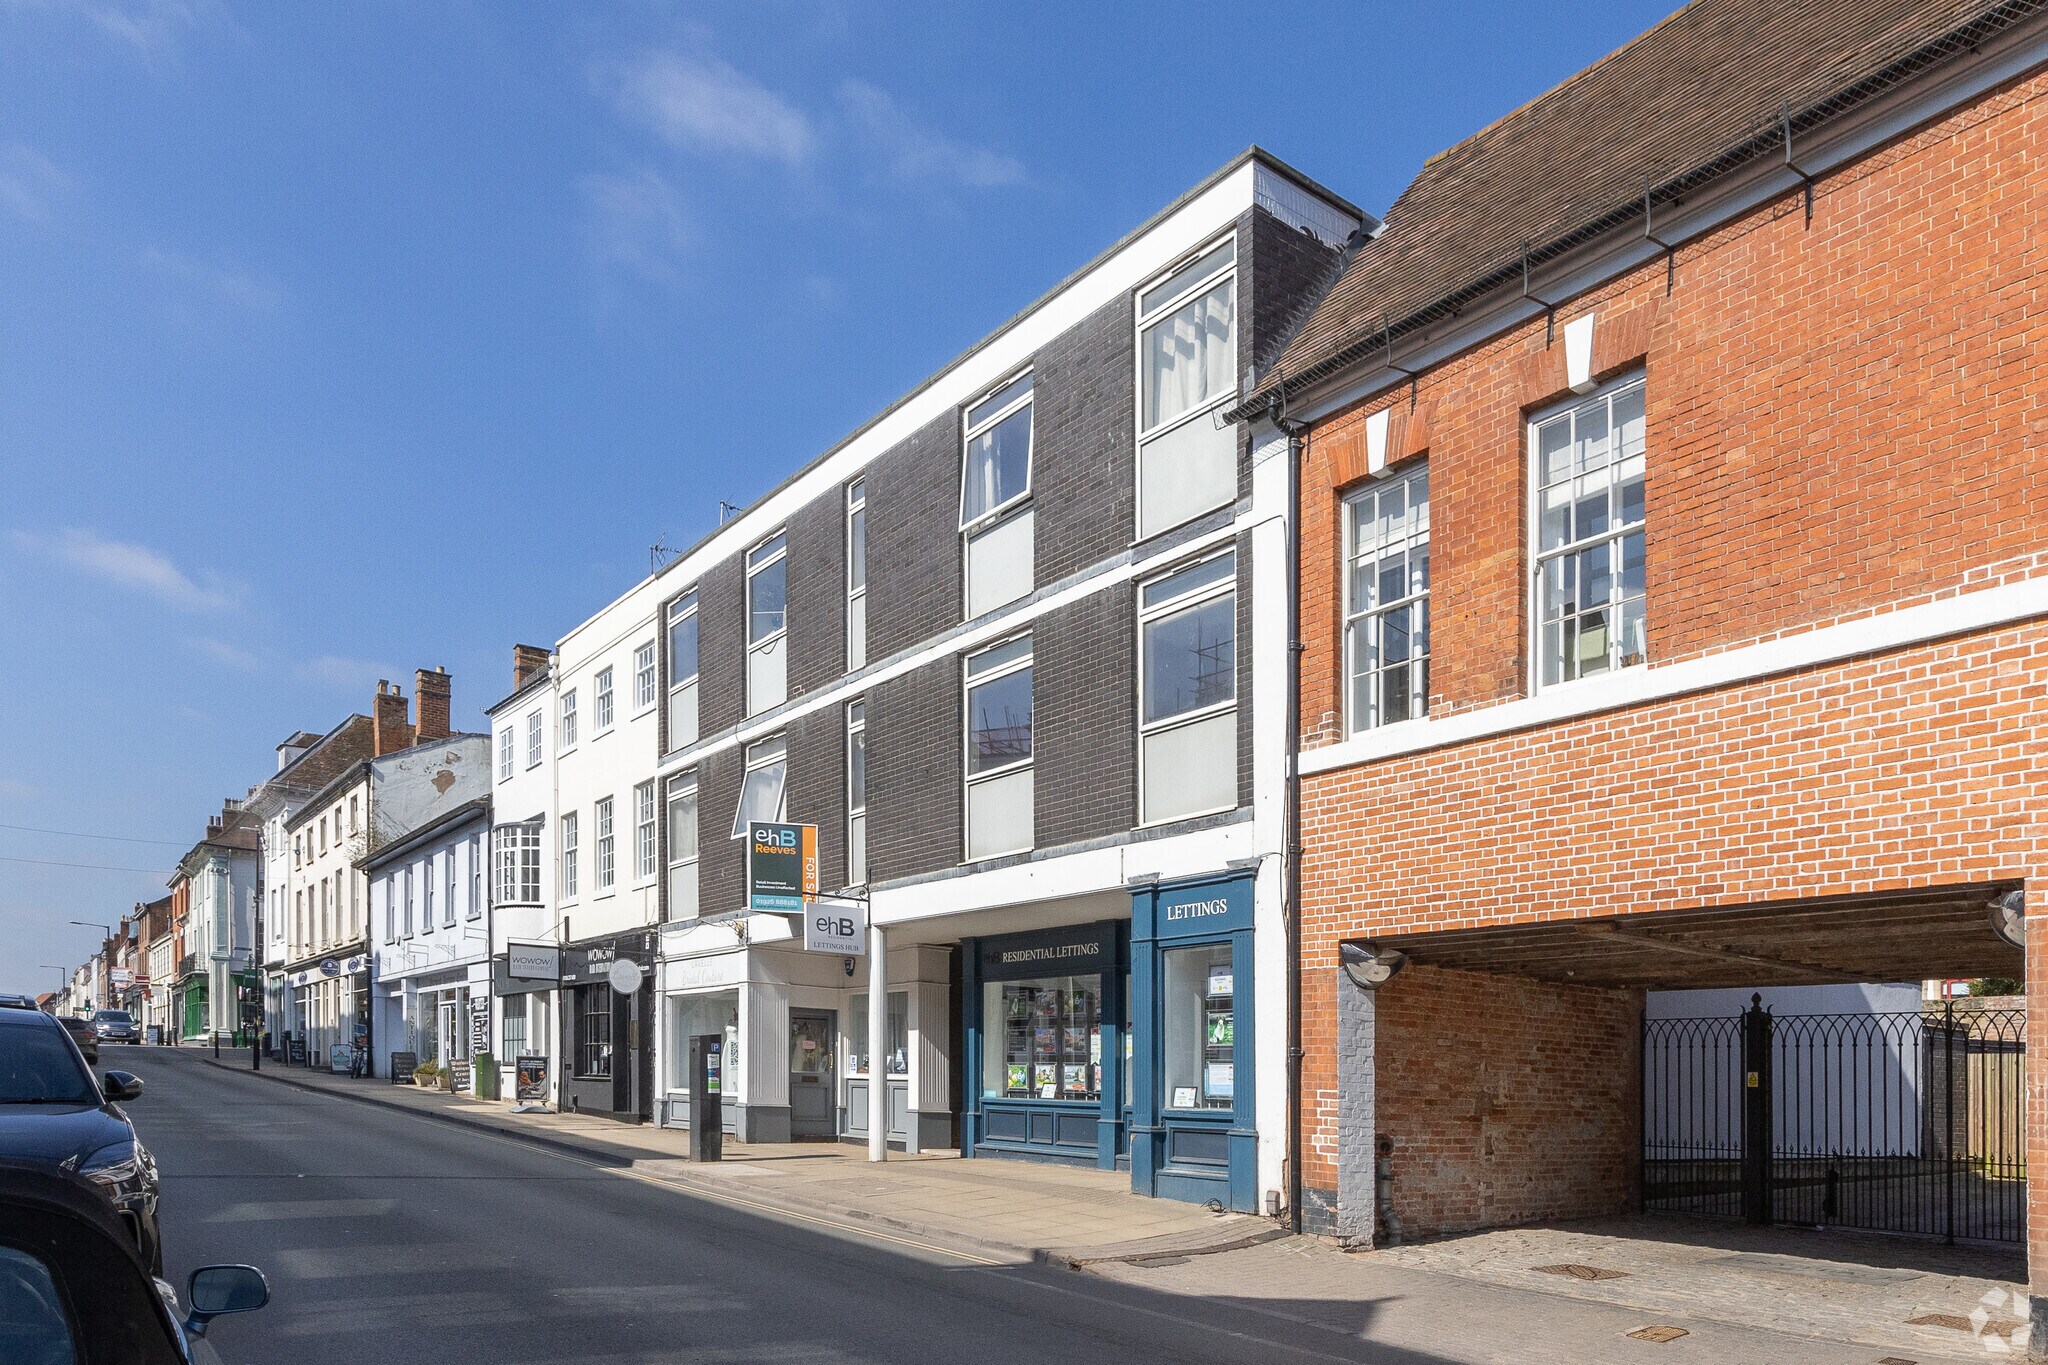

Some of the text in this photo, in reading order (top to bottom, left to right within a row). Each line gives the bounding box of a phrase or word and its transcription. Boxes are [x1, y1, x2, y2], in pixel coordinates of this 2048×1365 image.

[755, 829, 797, 847] ehB
[755, 843, 797, 855] Reeves
[805, 857, 815, 880] FOR
[1166, 898, 1228, 921] LETTINGS
[816, 916, 855, 937] ehB
[813, 941, 859, 952] LETTINGS HUB
[1003, 947, 1055, 963] RESIDENTIAL
[1056, 942, 1099, 958] LETTINGS
